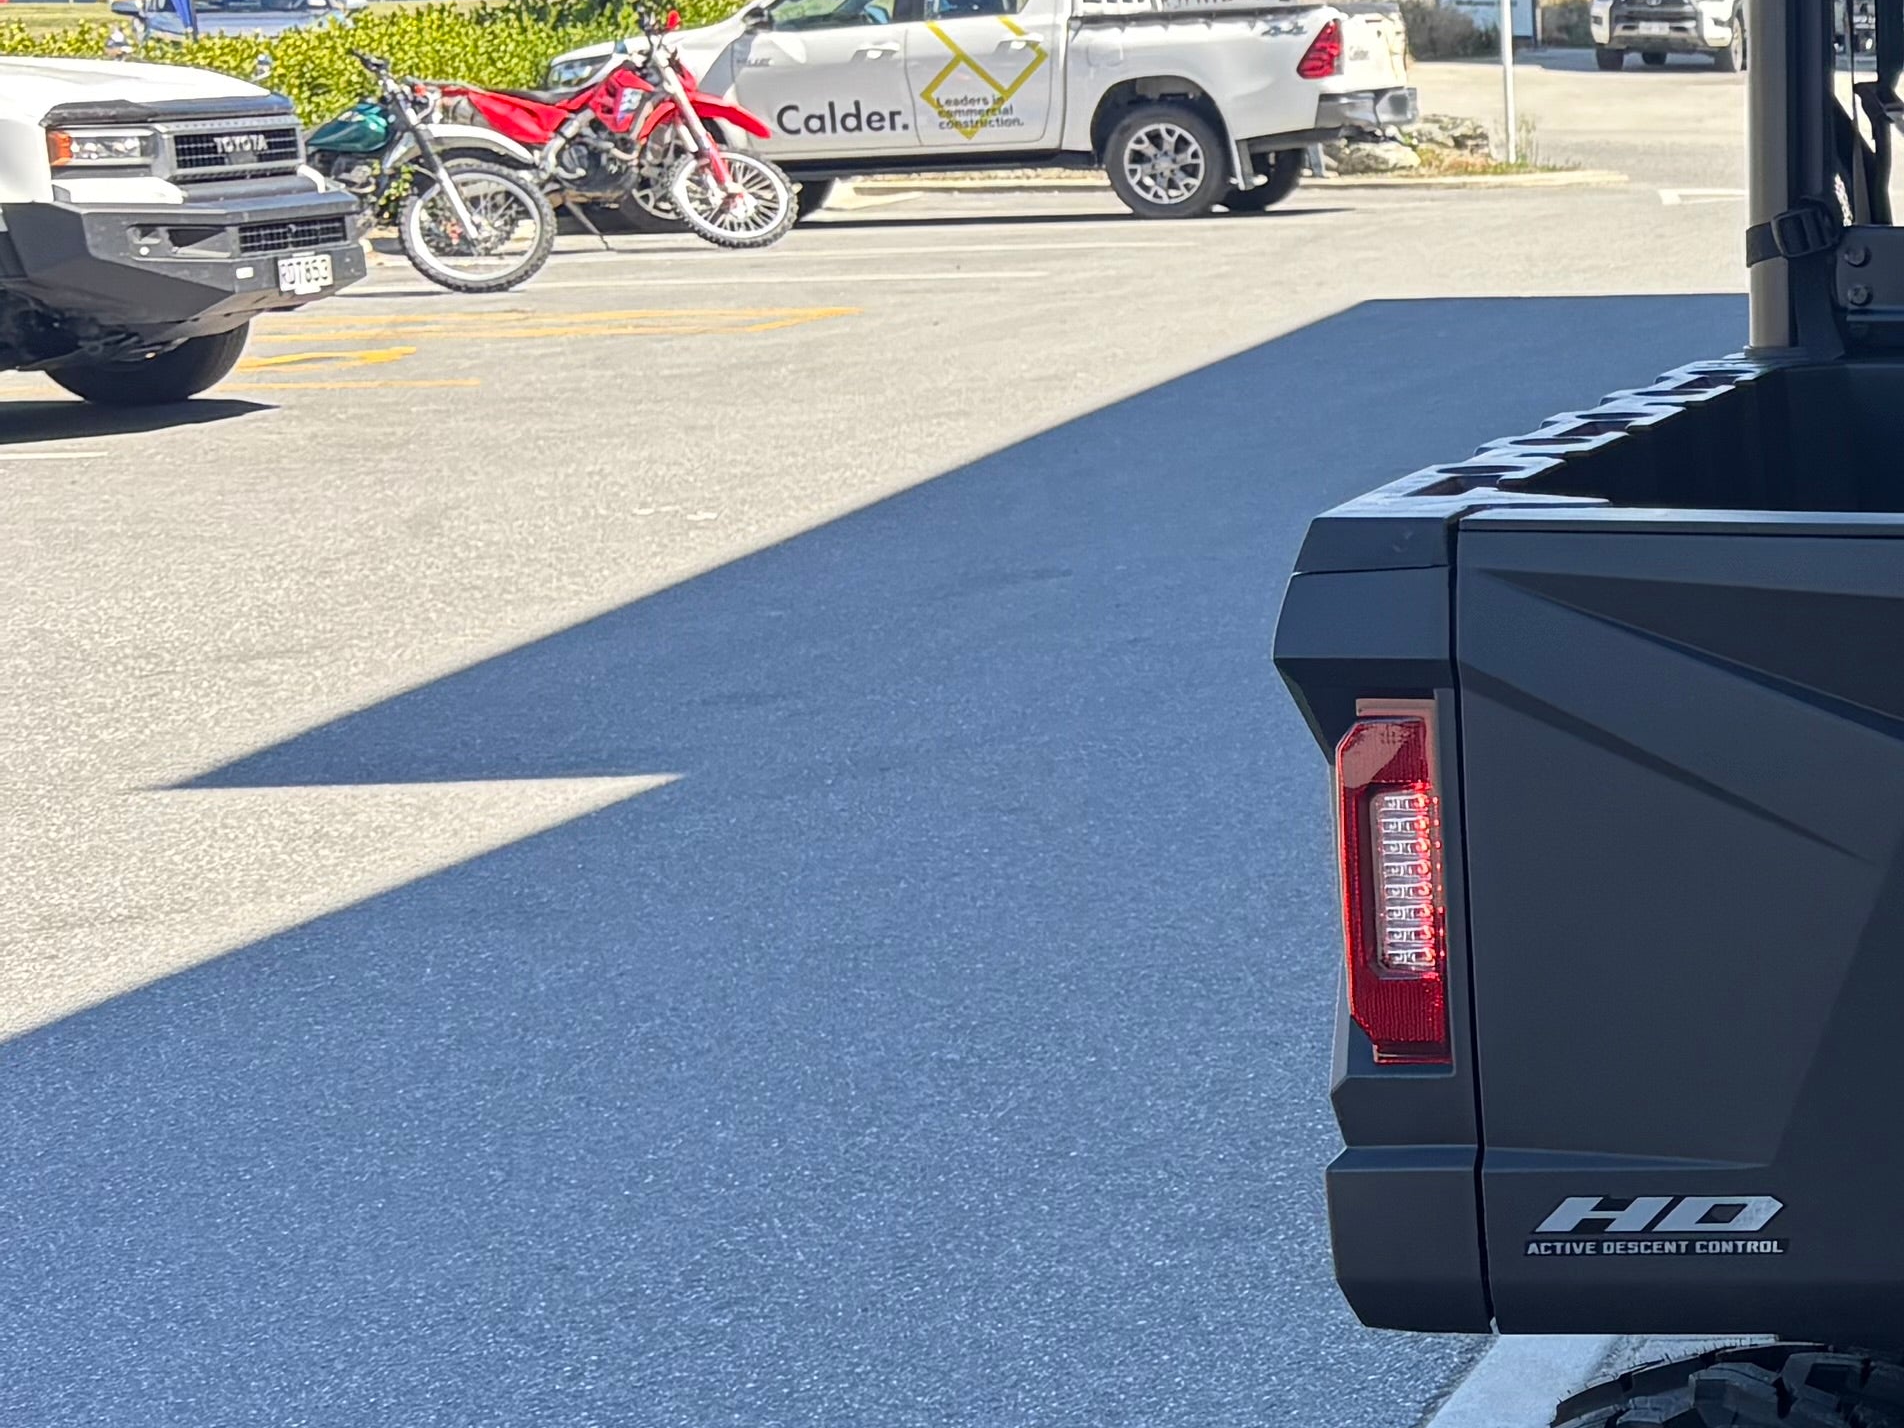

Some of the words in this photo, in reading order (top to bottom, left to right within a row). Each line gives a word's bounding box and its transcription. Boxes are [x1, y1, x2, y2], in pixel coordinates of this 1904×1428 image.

[936, 95, 989, 109] Leaders
[776, 100, 910, 136] Calder.
[937, 103, 1014, 119] commercial
[938, 117, 1025, 130] construction.
[213, 134, 269, 154] TOYOTA
[1532, 1195, 1785, 1233] HD
[1526, 1241, 1597, 1255] ACTIVE
[1602, 1240, 1689, 1254] DESCENT
[1695, 1240, 1784, 1254] CONTROL
